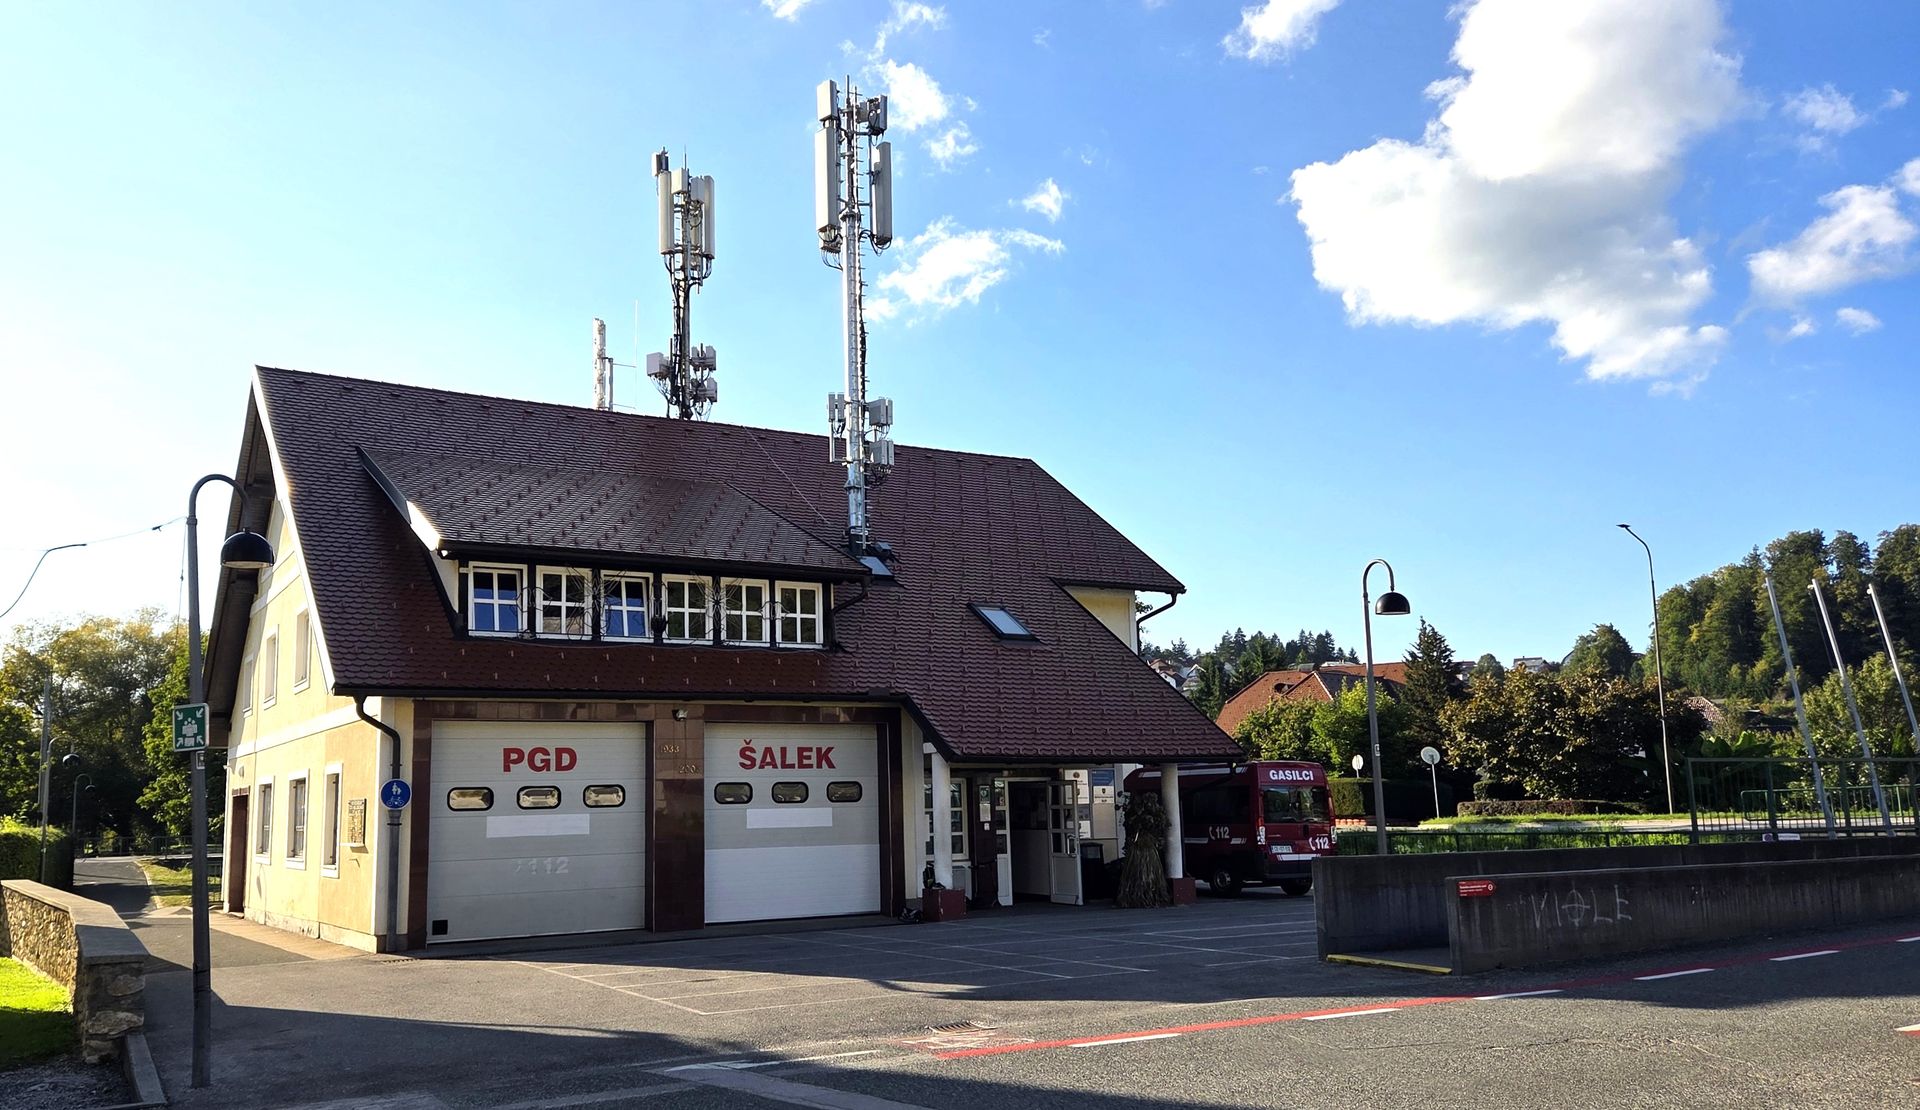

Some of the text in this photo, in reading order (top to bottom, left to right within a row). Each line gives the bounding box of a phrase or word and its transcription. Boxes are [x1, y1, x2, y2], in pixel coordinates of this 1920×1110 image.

[503, 747, 578, 773] PGD
[738, 739, 837, 770] ŠALEK
[1269, 770, 1314, 781] GASILCI
[1215, 826, 1230, 839] 112
[1315, 837, 1330, 849] 112
[528, 857, 569, 875] 112
